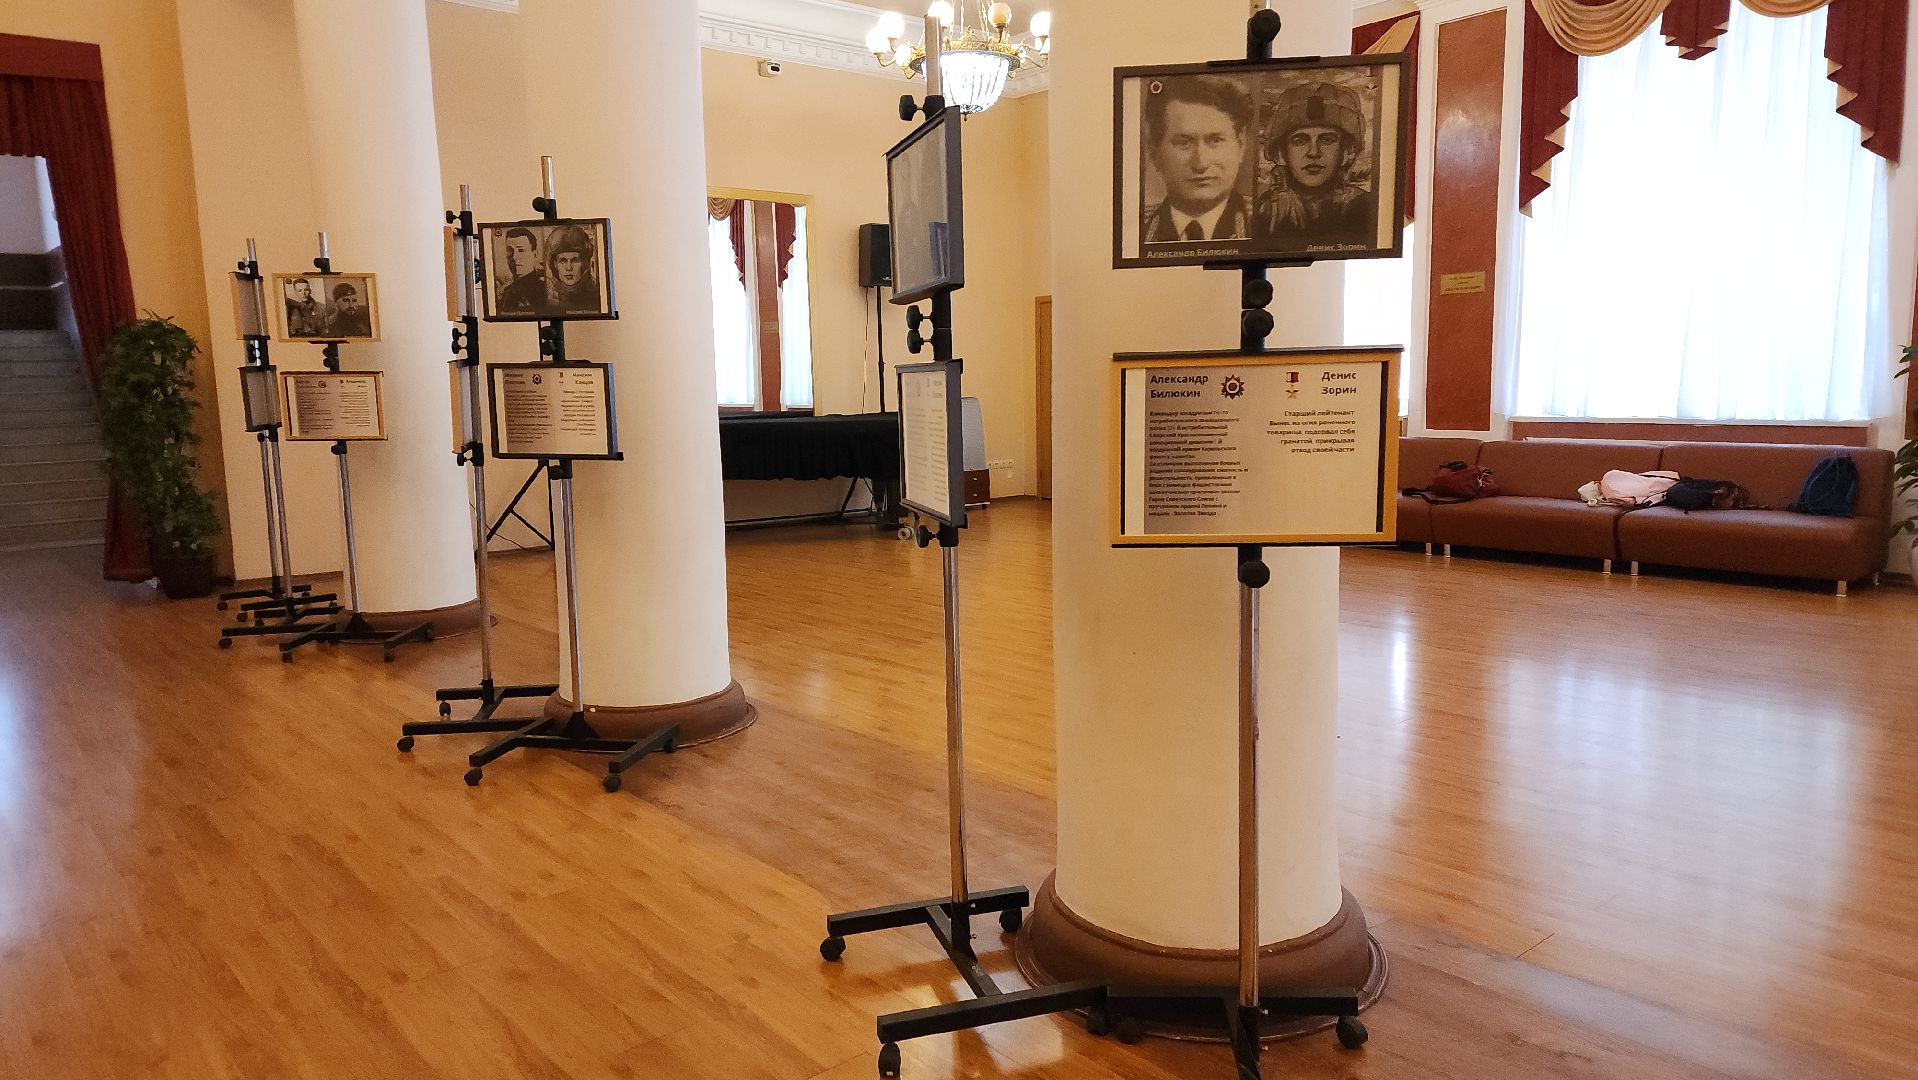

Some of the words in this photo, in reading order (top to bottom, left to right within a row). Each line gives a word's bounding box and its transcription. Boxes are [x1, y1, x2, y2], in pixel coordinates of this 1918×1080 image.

[1150, 375, 1208, 385] Александр
[1322, 372, 1356, 382] Денис
[1151, 390, 1200, 398] Билюкин
[1322, 386, 1356, 396] Зорин
